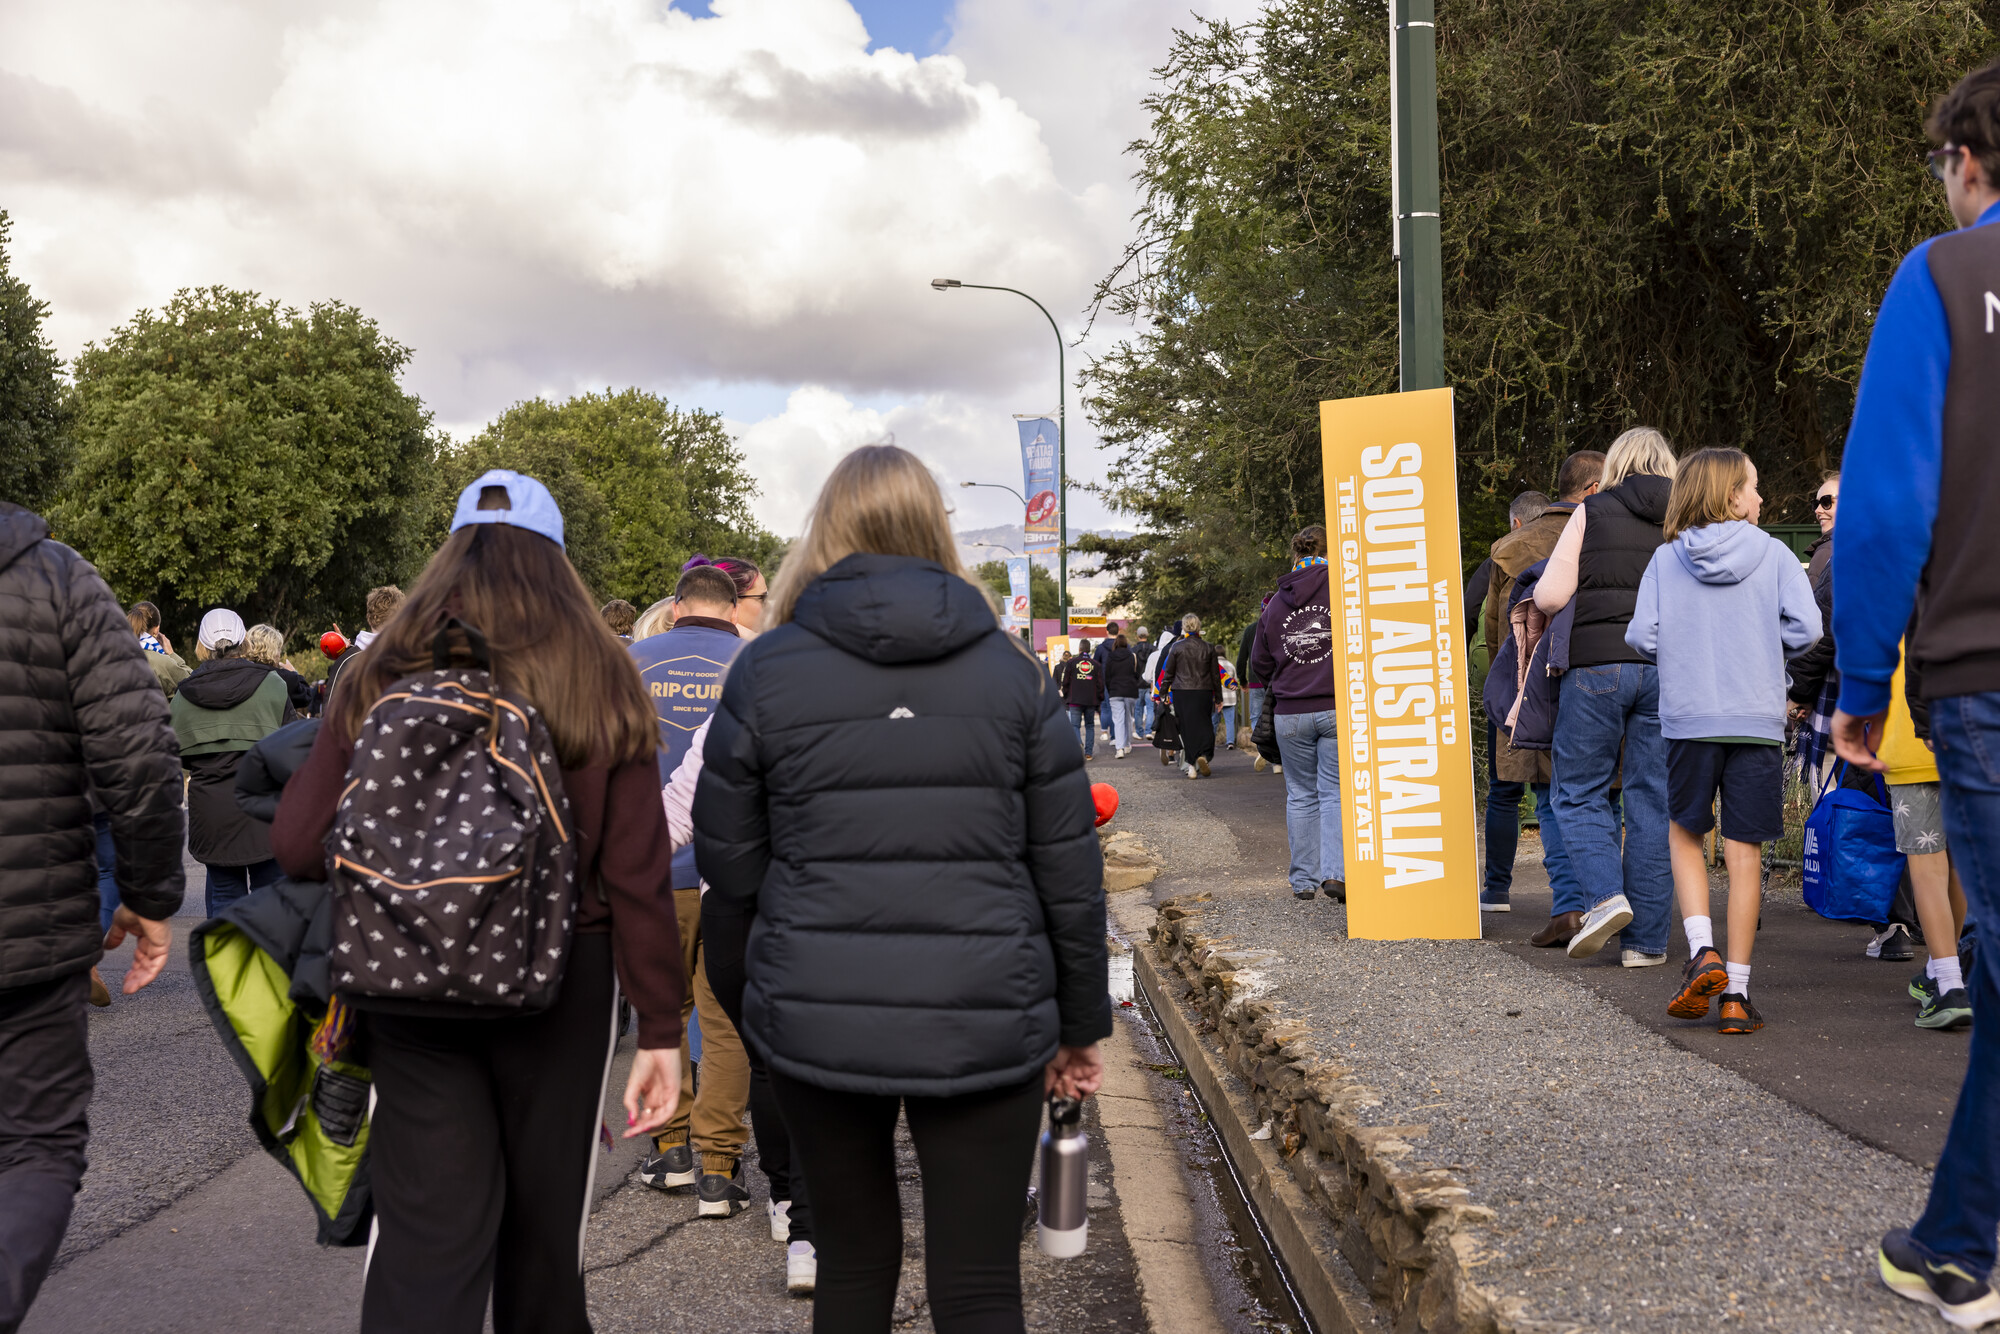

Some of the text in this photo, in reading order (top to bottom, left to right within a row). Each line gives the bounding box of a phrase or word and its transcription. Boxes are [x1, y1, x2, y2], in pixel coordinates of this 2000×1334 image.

[667, 669, 694, 677] QUALITY
[1338, 475, 1375, 861] THE GATHER ROUND STATE
[1361, 442, 1445, 889] SOUTH AUSTRALIA
[1434, 579, 1456, 745] WELCOME TO
[1804, 858, 1820, 873] ALDI
